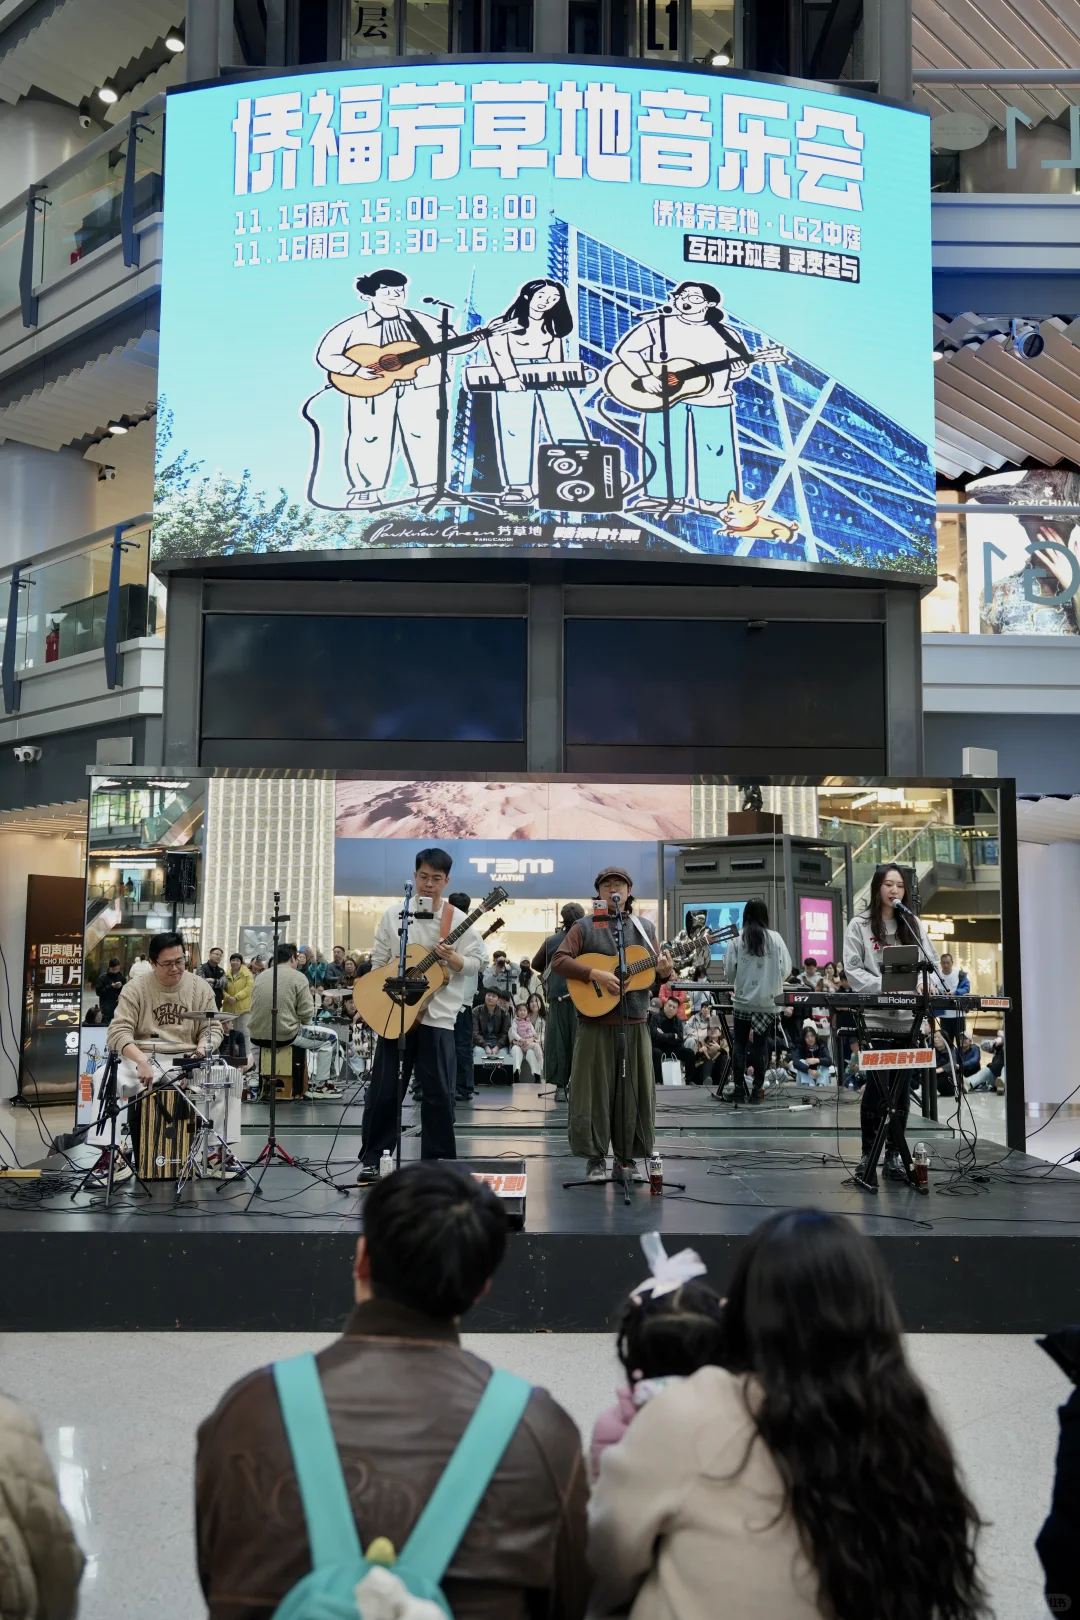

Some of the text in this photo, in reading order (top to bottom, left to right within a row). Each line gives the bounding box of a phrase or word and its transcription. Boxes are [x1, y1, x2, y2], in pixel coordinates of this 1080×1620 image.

[354, 7, 388, 39] 层
[648, 0, 677, 50] L1
[231, 80, 865, 212] 侨福芳草地音乐会
[233, 194, 537, 236] 11.15周六 15:00-18:00
[233, 226, 537, 267] 11.16周日 13:30-16:30
[688, 235, 858, 281] 互动开放麦 免费参与
[369, 523, 495, 542] Parkview Green
[497, 525, 543, 537] 芳草地
[40, 944, 82, 957] 回声唱片
[888, 996, 917, 1005] Roland
[861, 1050, 933, 1066] 路演計劃
[474, 1175, 526, 1191] 計劃
